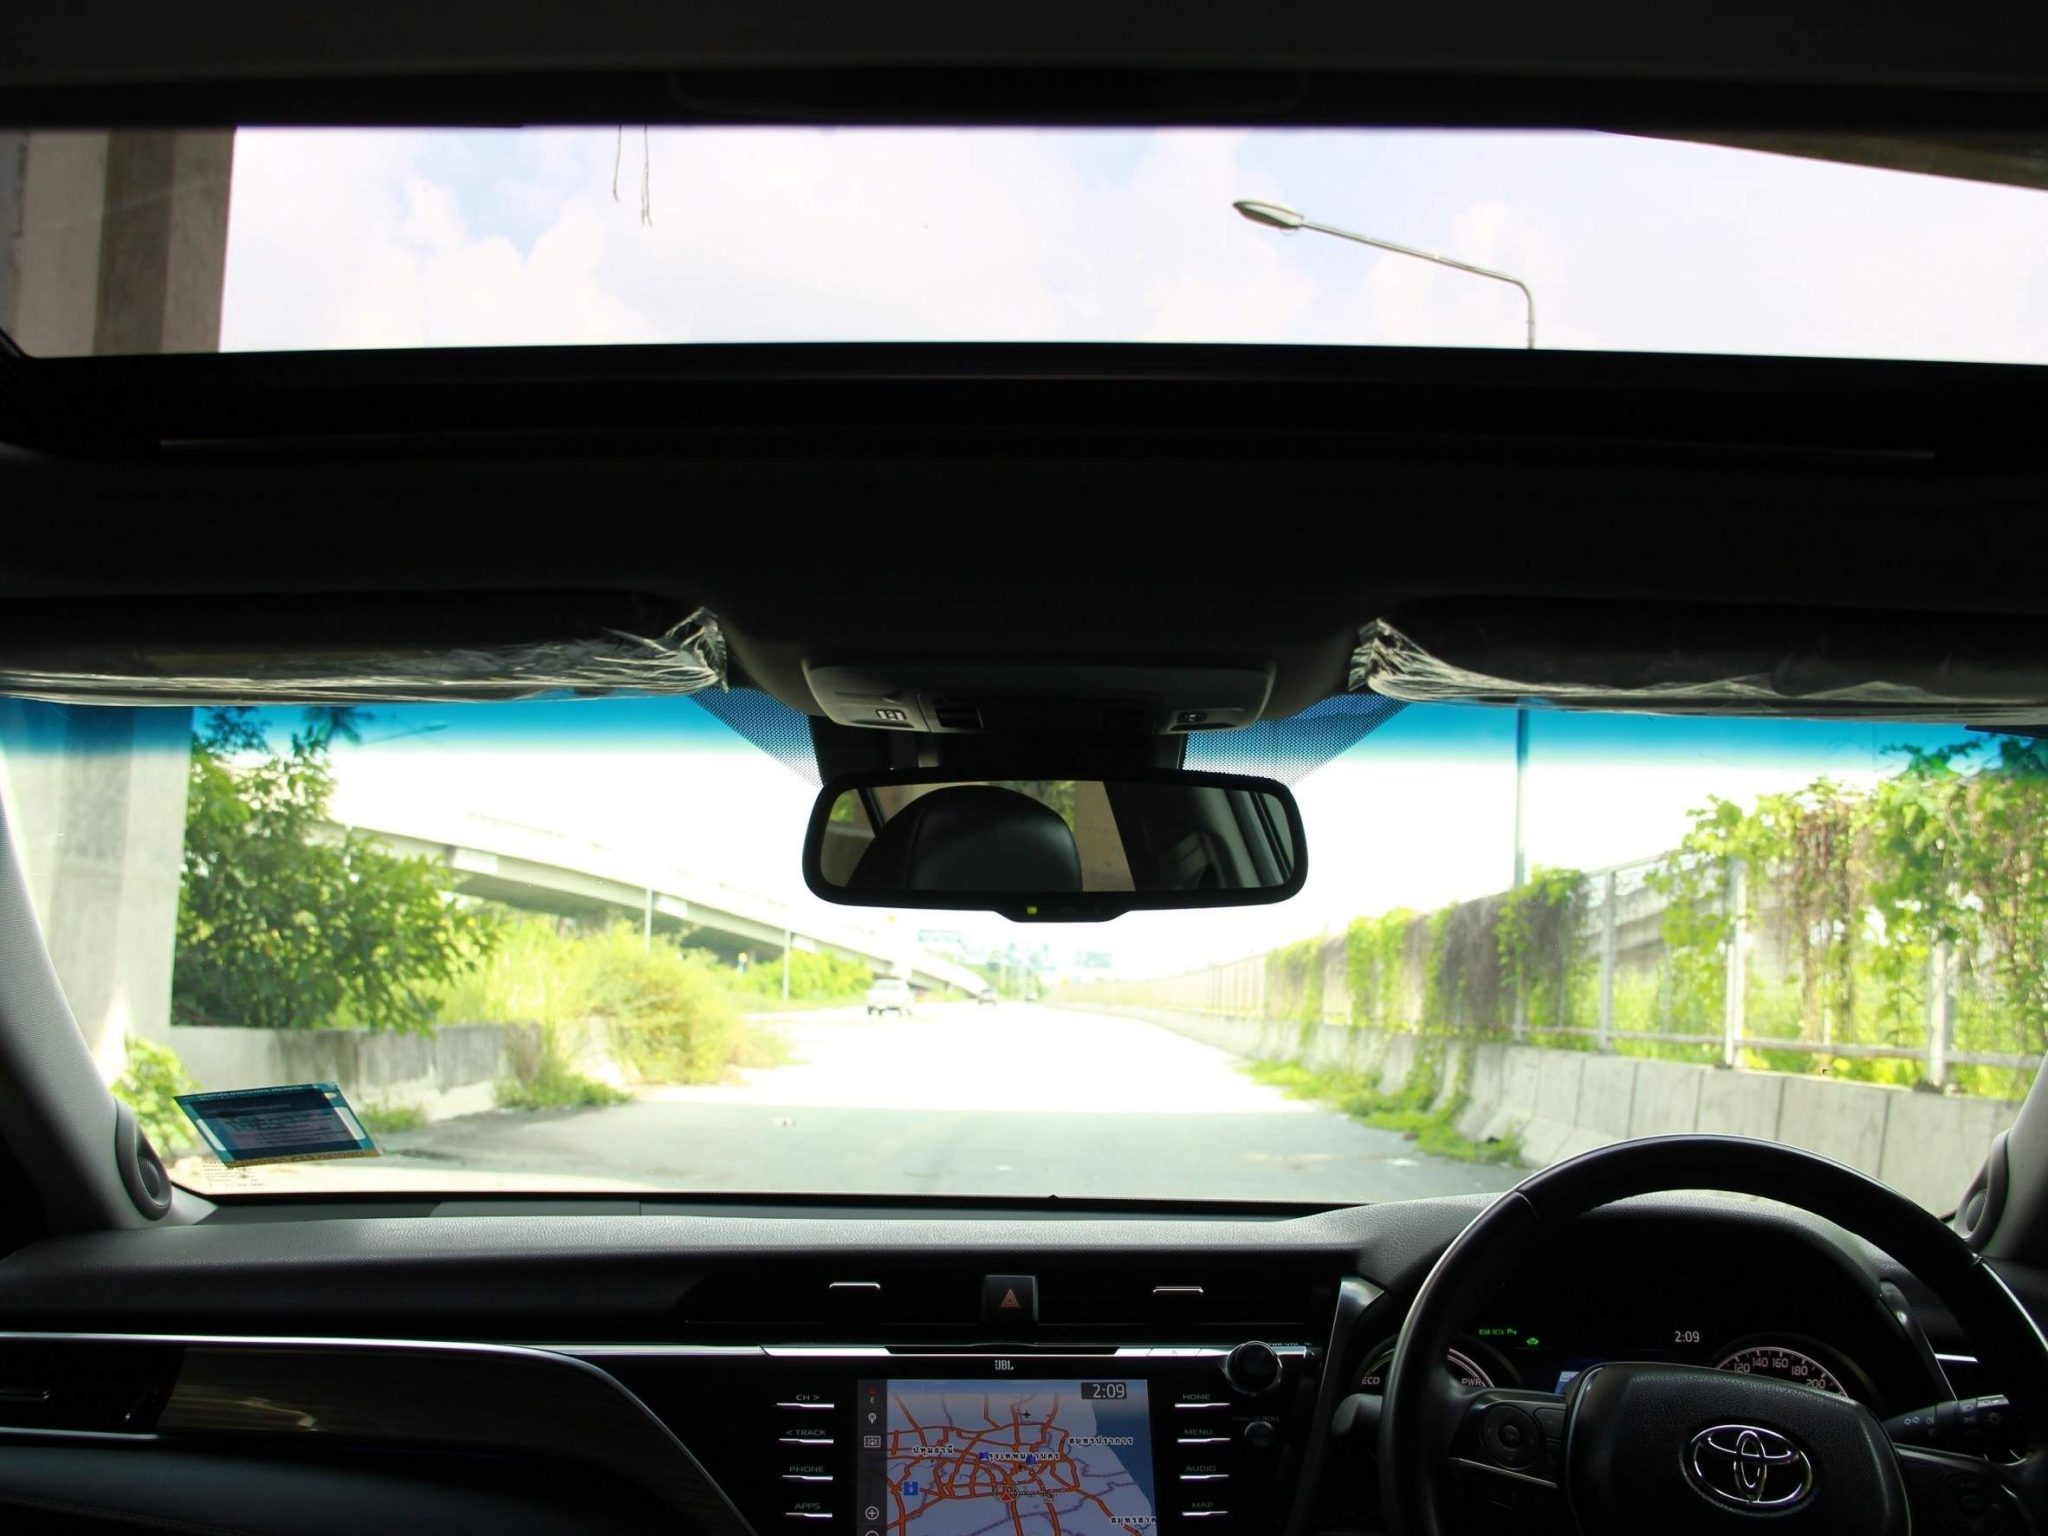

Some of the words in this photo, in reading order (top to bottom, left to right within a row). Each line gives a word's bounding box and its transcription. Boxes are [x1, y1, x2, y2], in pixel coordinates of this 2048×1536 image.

[1674, 1330, 1700, 1343] 2:09
[994, 1359, 1014, 1371] JBL
[1733, 1361, 1751, 1373] 120
[1752, 1357, 1769, 1368] 140
[1772, 1357, 1789, 1368] 160
[1791, 1365, 1808, 1376] 180
[1361, 1376, 1381, 1386] ECO
[1460, 1377, 1481, 1387] PWR
[1807, 1378, 1825, 1389] 200
[1091, 1383, 1125, 1399] 2:09
[1182, 1392, 1211, 1400] HOME
[796, 1393, 810, 1401] CH
[796, 1428, 827, 1437] TRACK
[1184, 1428, 1212, 1436] MENU
[789, 1465, 824, 1473] PHONE
[1184, 1465, 1216, 1473] AUDIO
[793, 1502, 821, 1510] APPS
